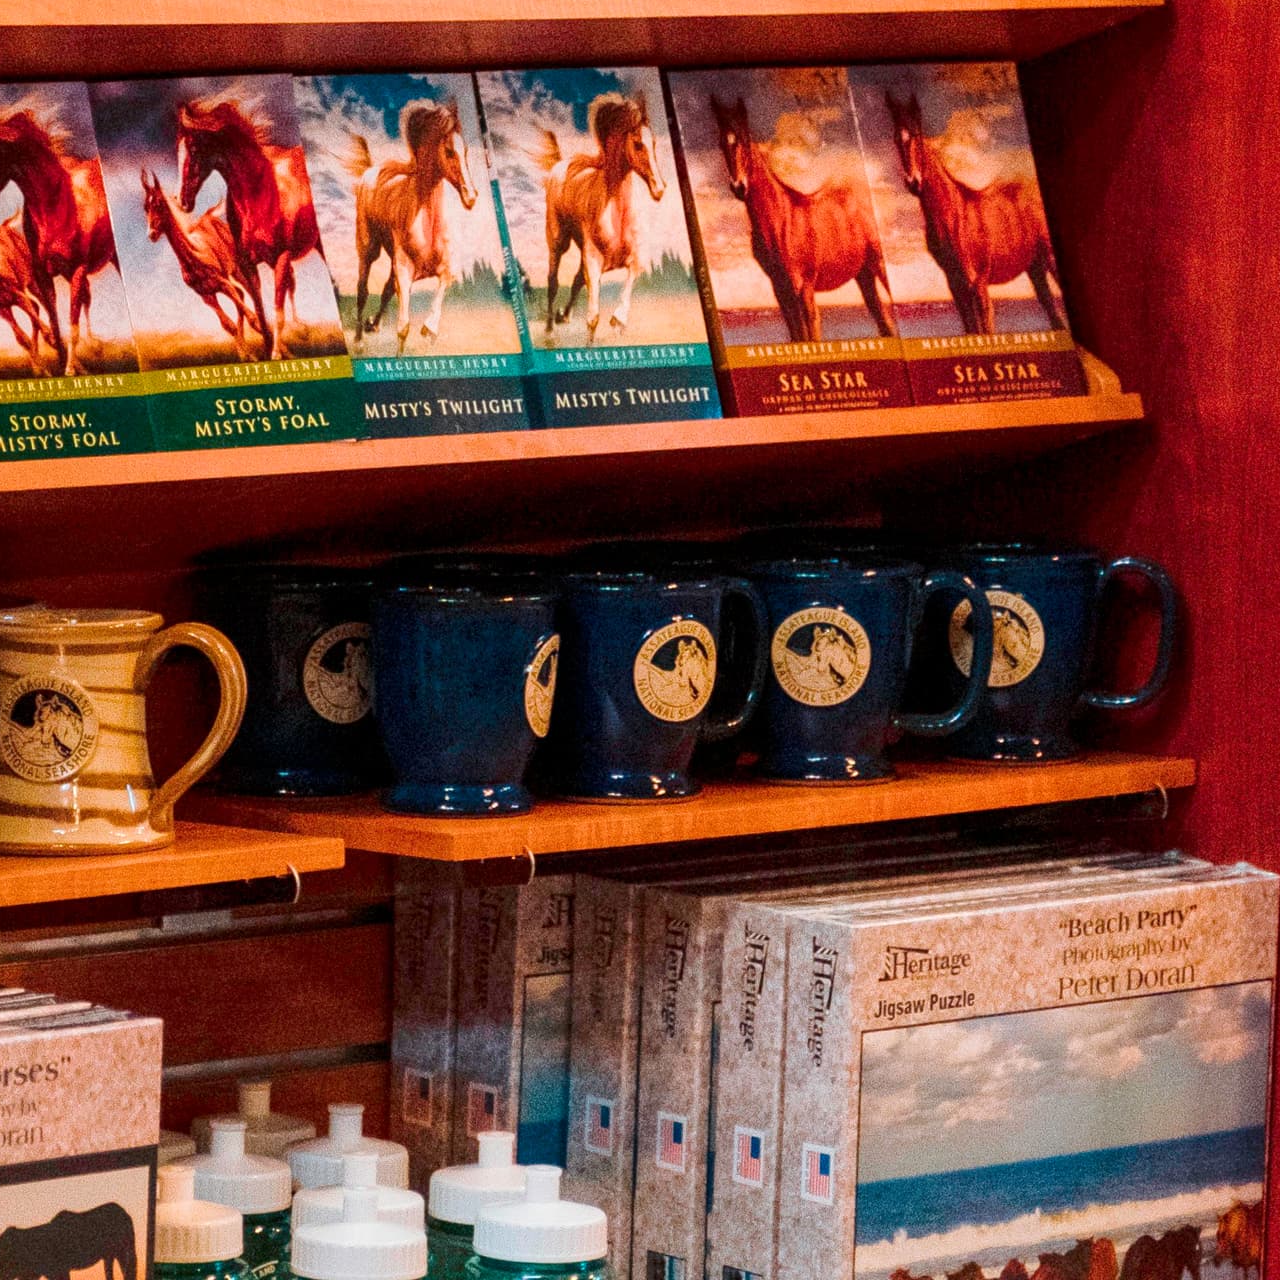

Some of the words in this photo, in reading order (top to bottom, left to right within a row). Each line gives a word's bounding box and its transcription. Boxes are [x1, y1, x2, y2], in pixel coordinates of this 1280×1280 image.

[364, 358, 459, 373] MARGUERITE
[462, 357, 508, 369] HENRY
[555, 349, 647, 364] MARGUERITE
[650, 346, 696, 358] HENRY
[166, 364, 275, 380] MARGUERITE
[279, 359, 333, 373] HENRY
[955, 364, 987, 383] SEA
[994, 362, 1040, 380] STAR
[73, 374, 125, 390] HENRY
[779, 372, 813, 392] SEA
[821, 371, 868, 389] STAR
[364, 401, 432, 419] MISTY'S
[438, 398, 524, 416] TWILIGHT
[555, 390, 621, 409] MISTY'S
[626, 387, 710, 405] TWILIGHT
[195, 416, 271, 438] MISTY'S
[280, 413, 330, 428] FOAL
[72, 431, 120, 448] FOAL
[775, 661, 818, 703] NATIONAL
[820, 662, 867, 703] SEASHORE
[2, 734, 41, 779] NATIONAL
[43, 732, 94, 779] SEASHORE
[1062, 939, 1164, 966] Photography
[1167, 934, 1191, 954] by
[879, 946, 970, 982] Heritage
[742, 920, 770, 1052] Heritage
[1058, 972, 1121, 1000] Peter
[1127, 964, 1194, 991] Doran
[808, 935, 838, 1068] Heritage
[874, 996, 926, 1019] Jigsaw
[929, 990, 975, 1011] Puzzle
[20, 1100, 41, 1117] by
